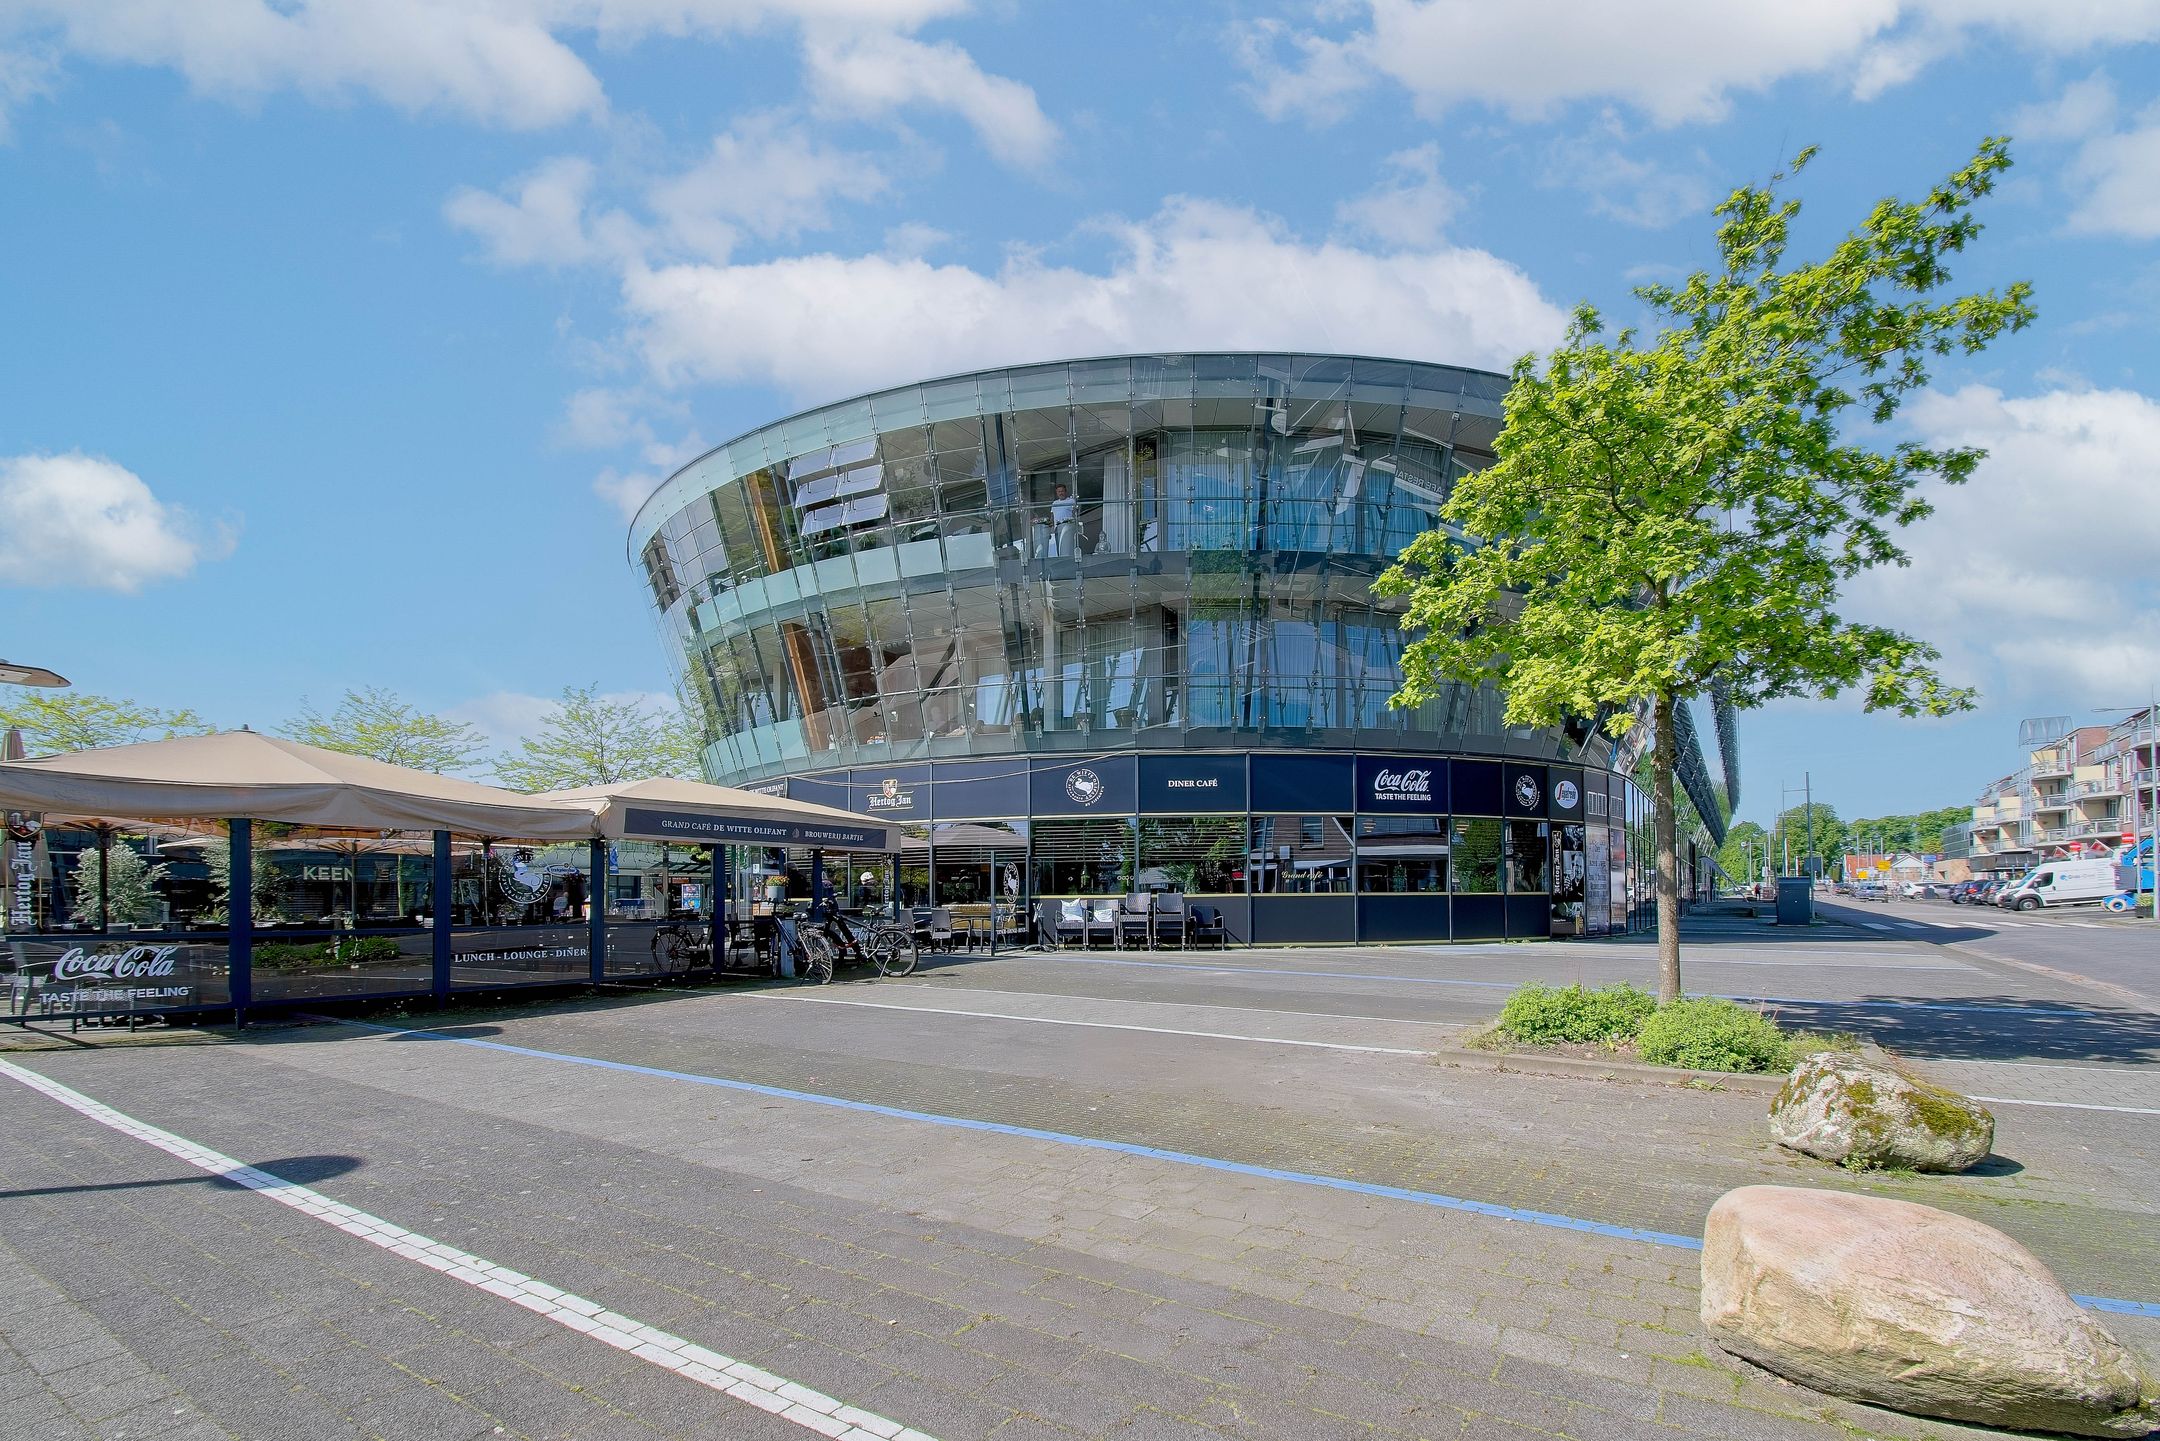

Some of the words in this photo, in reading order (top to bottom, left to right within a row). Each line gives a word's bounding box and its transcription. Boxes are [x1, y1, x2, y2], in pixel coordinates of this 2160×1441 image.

[1167, 780, 1195, 788] DINER
[1196, 778, 1218, 787] CAFÉ
[868, 796, 896, 809] Hertog
[896, 794, 912, 808] Jan
[1374, 793, 1394, 801] TASTE
[1394, 793, 1406, 801] THE
[1406, 793, 1432, 802] FEELING
[661, 820, 691, 829] GRAND
[691, 822, 712, 831] CAFÉ
[713, 824, 725, 832] DE
[726, 825, 753, 833] WITTE
[754, 827, 787, 836] OLIFANT
[804, 830, 841, 840] BROUWERIJ
[842, 834, 864, 842] BARTJE
[303, 867, 353, 881] KEEN
[11, 872, 38, 926] Hertog
[454, 952, 495, 963] LUNCH
[503, 950, 548, 960] LOUNGE
[555, 948, 587, 958] DINER
[55, 946, 178, 981] Coca-Cola
[39, 990, 89, 1004] TASTE
[91, 989, 124, 1002] THE
[127, 986, 190, 999] FEELING
